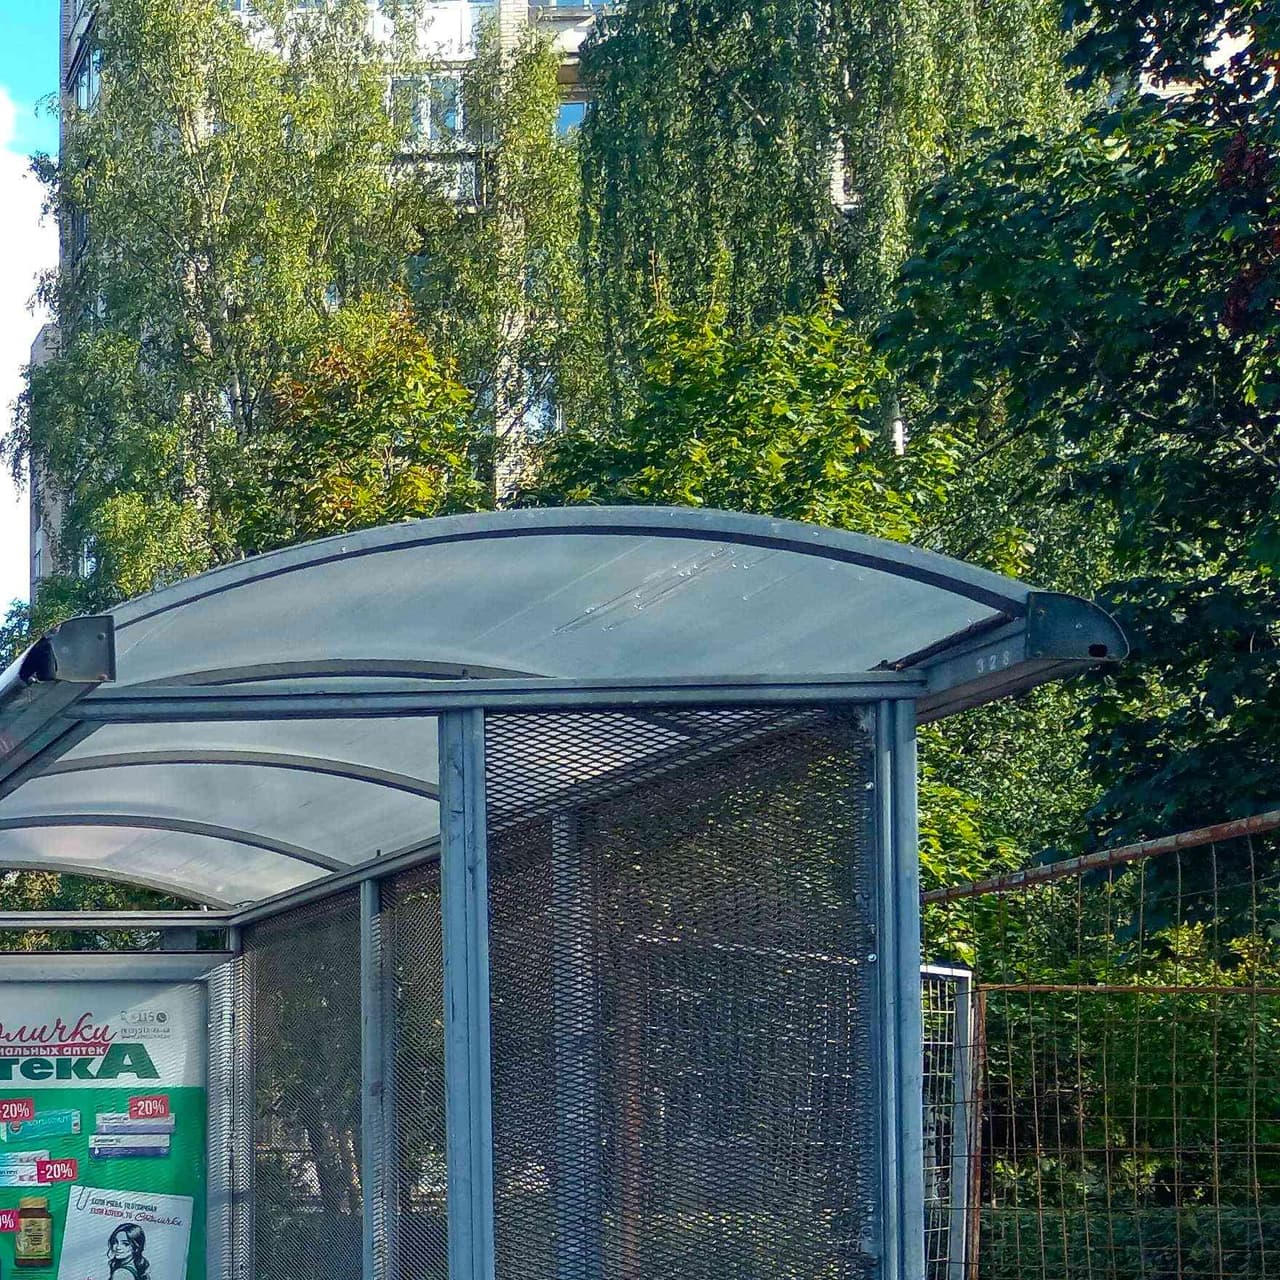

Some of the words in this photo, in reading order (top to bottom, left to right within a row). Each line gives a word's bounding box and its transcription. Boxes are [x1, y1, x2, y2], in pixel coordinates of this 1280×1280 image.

[976, 651, 1009, 673] 328
[62, 1046, 105, 1056] аптек
[131, 1100, 164, 1116] -20%
[40, 1163, 73, 1179] -20%
